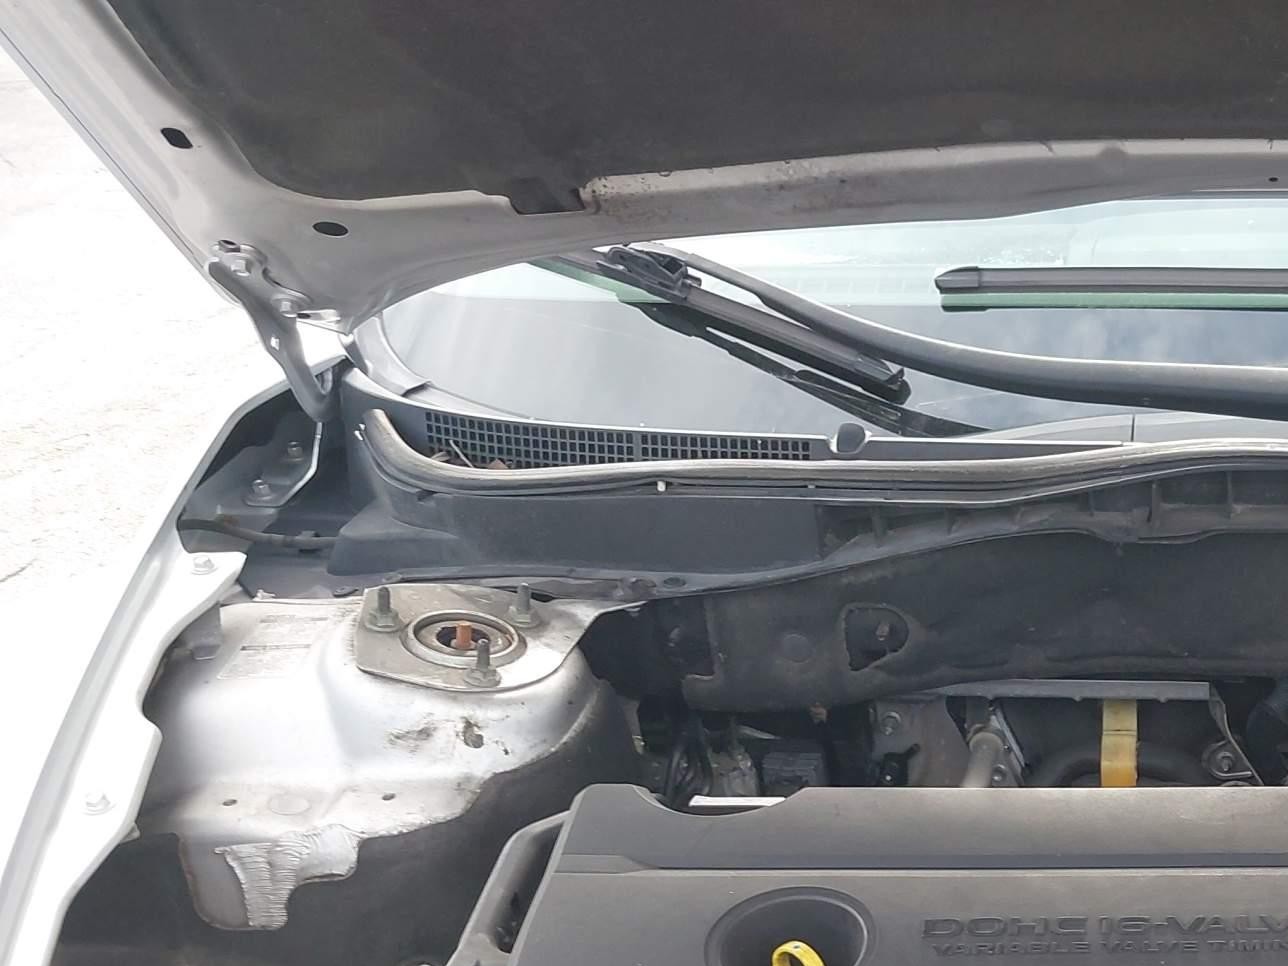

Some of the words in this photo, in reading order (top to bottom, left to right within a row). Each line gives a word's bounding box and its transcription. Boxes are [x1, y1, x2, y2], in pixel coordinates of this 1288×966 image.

[922, 916, 1090, 937] DOHC
[931, 940, 1091, 957] VARIABLE
[1102, 939, 1200, 954] VALVE
